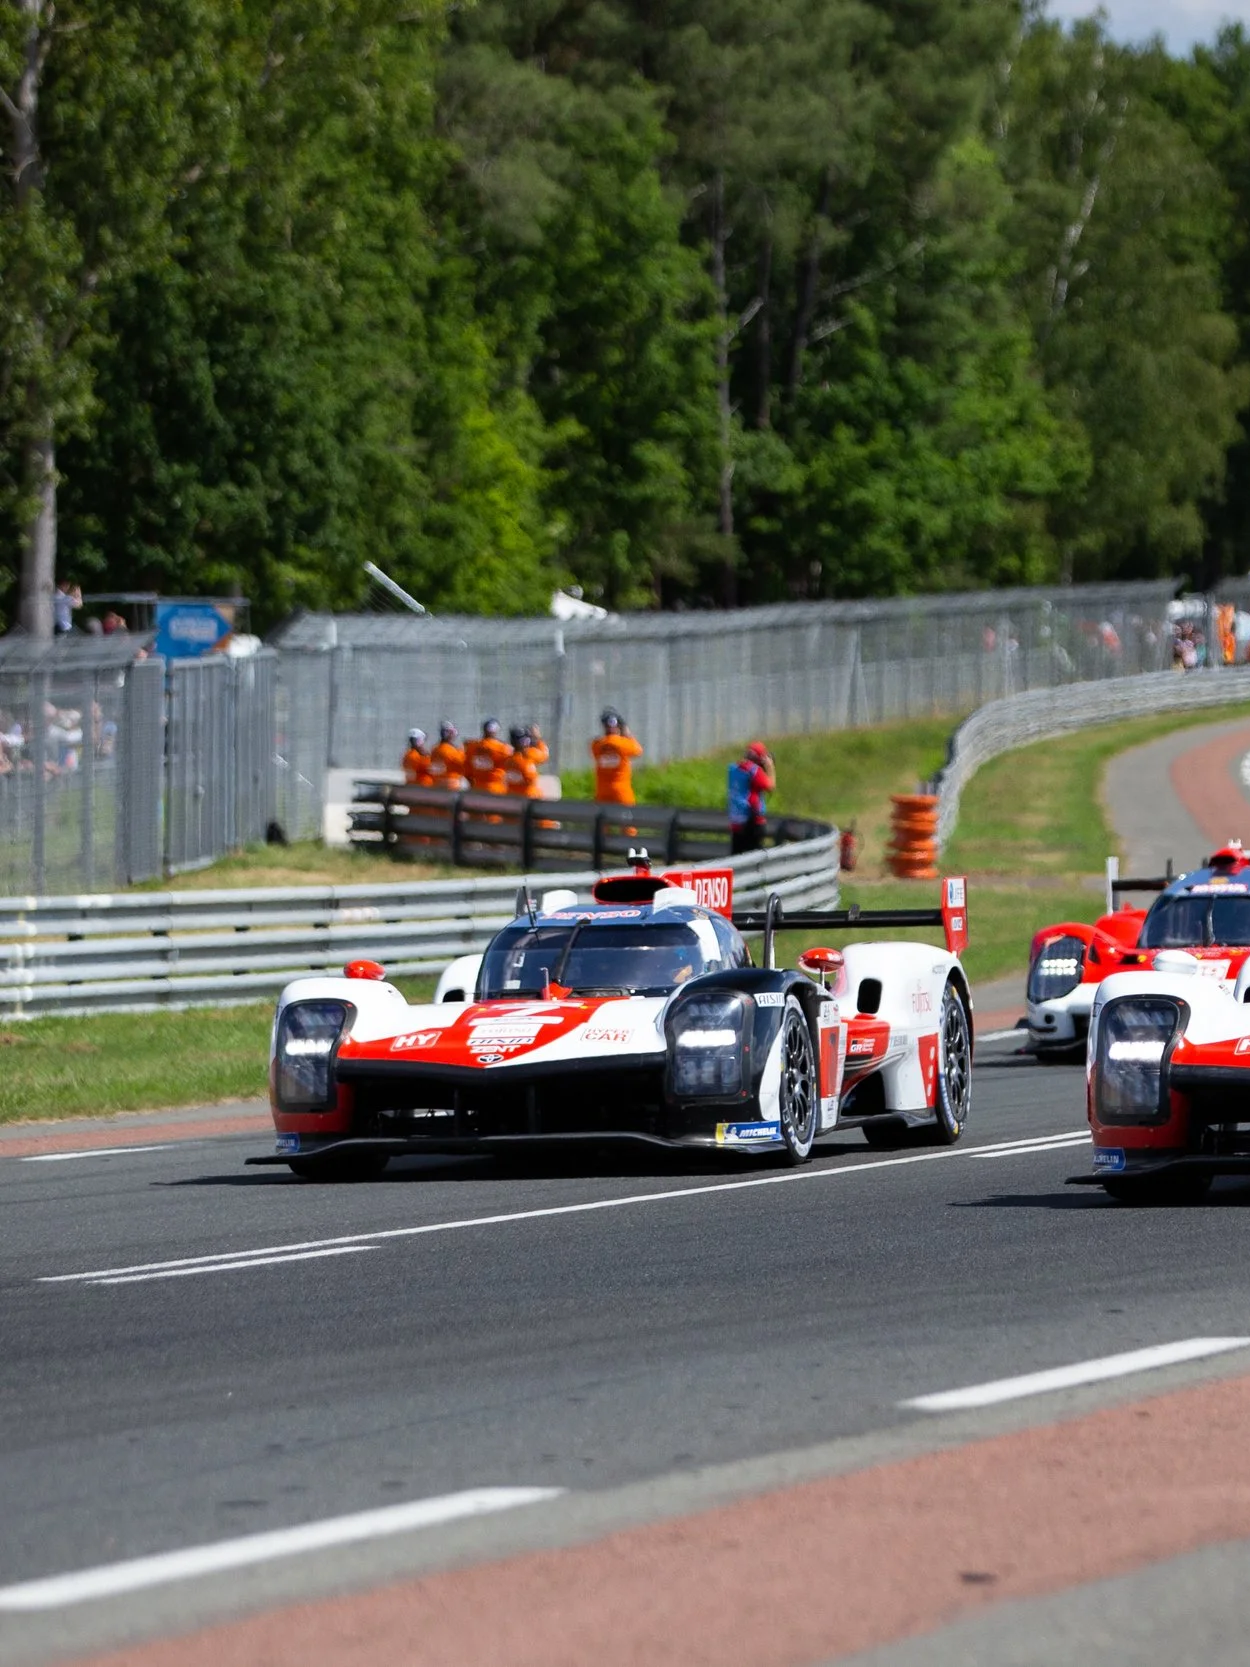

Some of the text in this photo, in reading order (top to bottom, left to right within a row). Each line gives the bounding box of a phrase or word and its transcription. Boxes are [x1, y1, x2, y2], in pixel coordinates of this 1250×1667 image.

[696, 877, 728, 908] DENSO
[395, 1034, 437, 1048] HY
[584, 1033, 627, 1041] CAR
[470, 1046, 521, 1055] ZENT
[740, 1127, 777, 1138] MICHELIN
